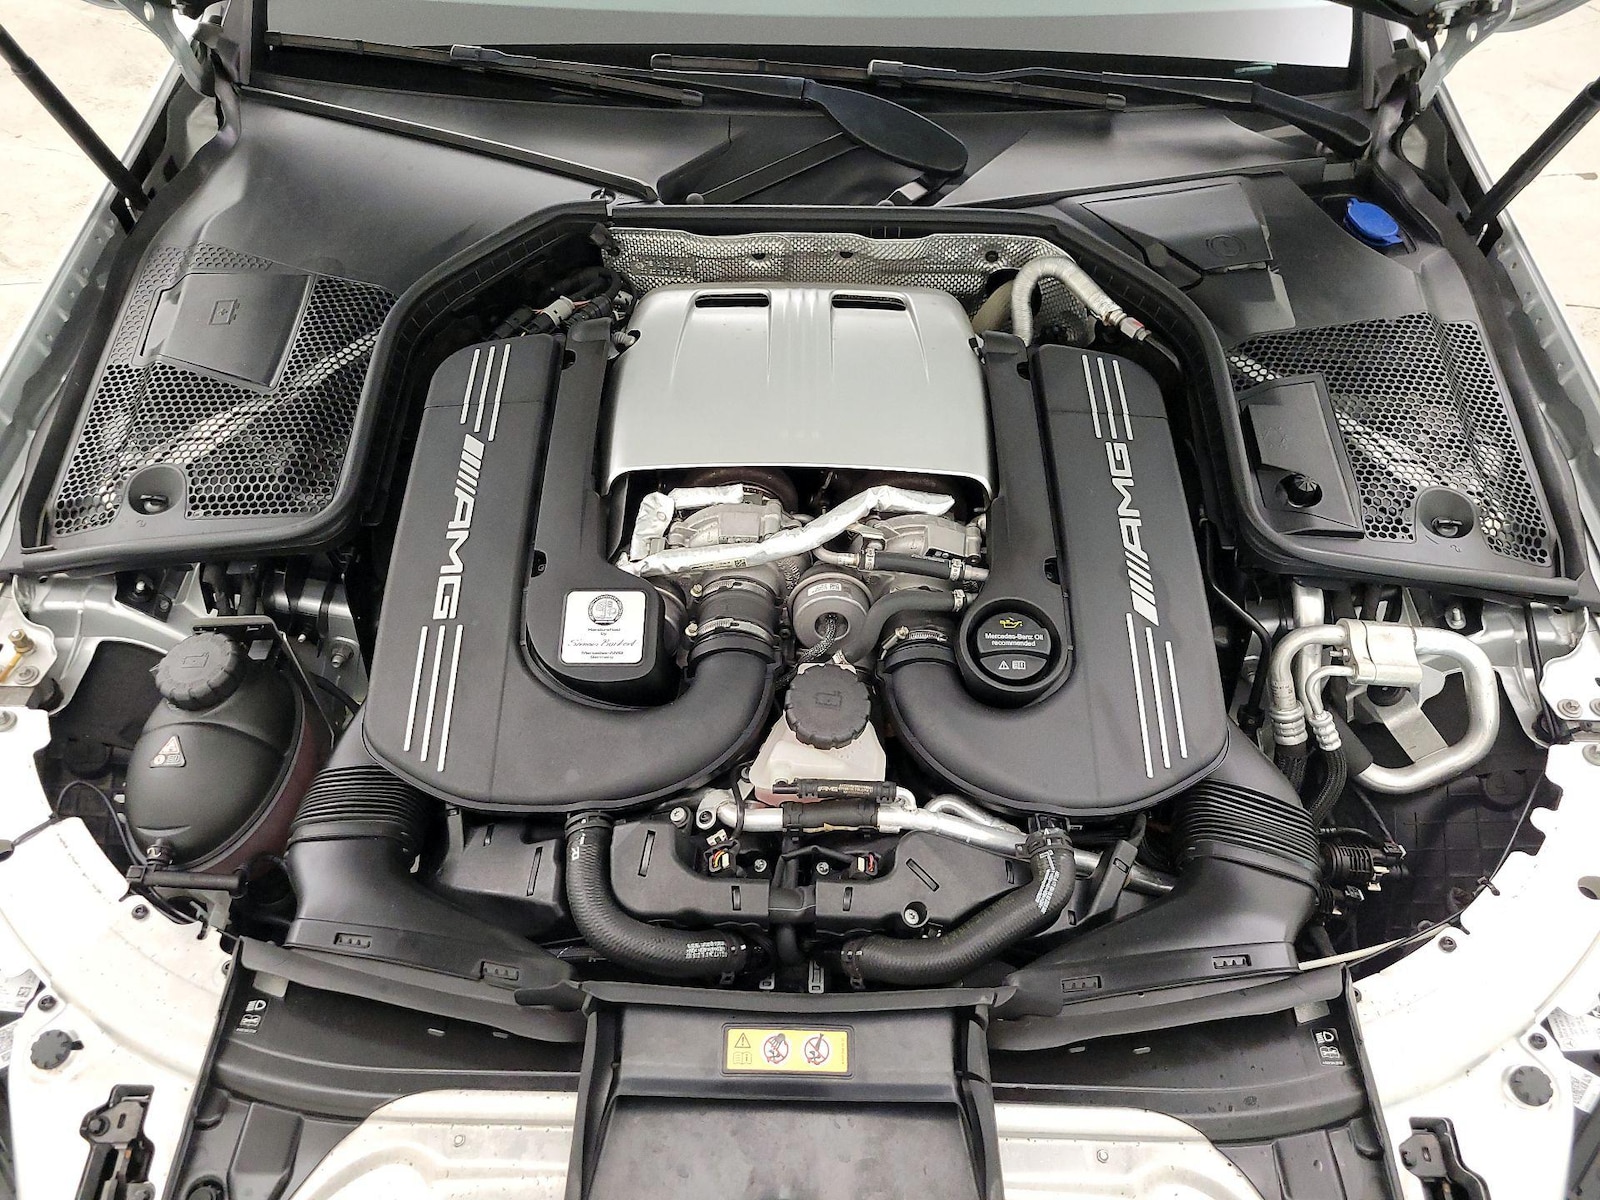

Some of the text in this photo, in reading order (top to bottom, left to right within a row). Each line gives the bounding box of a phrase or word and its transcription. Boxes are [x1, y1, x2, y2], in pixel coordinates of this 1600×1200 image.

[433, 486, 476, 620] AMG
[1105, 441, 1150, 563] AMG
[984, 632, 1034, 640] Mercedes-Benz
